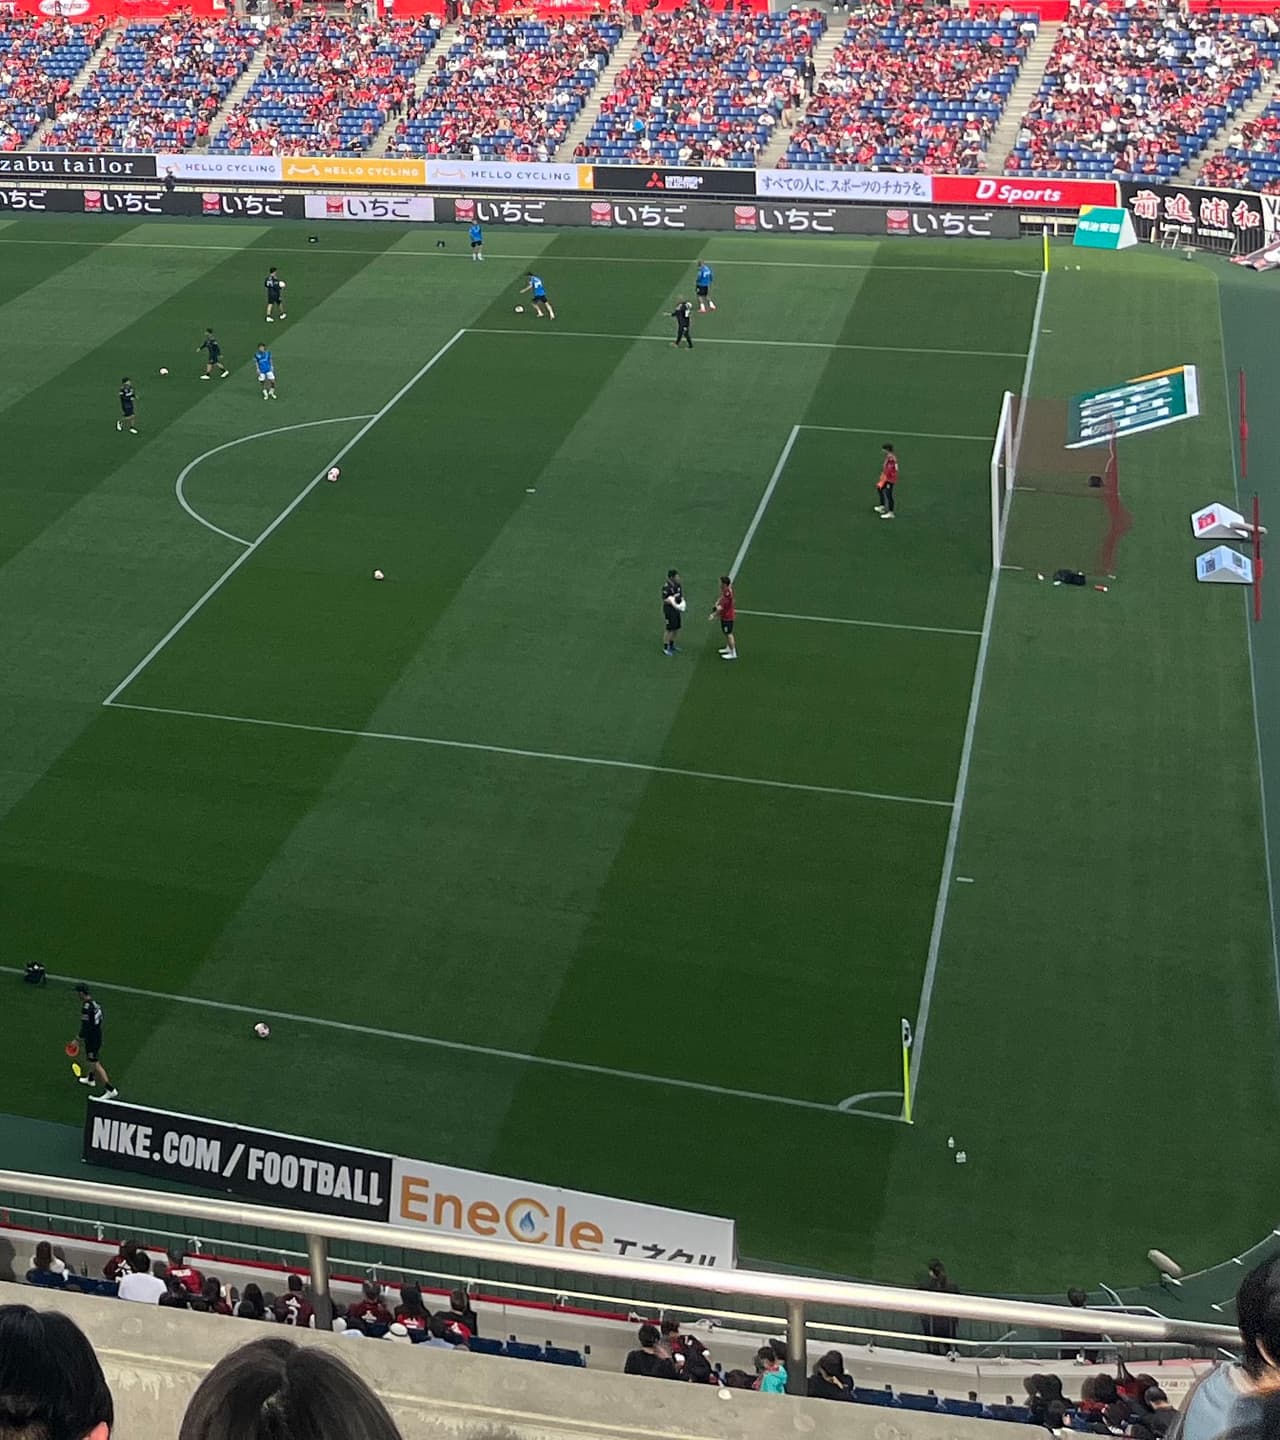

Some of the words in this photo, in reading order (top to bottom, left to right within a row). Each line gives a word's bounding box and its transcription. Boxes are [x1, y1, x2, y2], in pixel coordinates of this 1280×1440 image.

[64, 158, 134, 174] tailor
[185, 162, 223, 172] HELLO
[226, 163, 276, 173] CYCLING
[324, 166, 365, 177] HELLO
[368, 167, 421, 178] CYCLING
[471, 170, 512, 181] HELLO
[516, 170, 571, 182] CYCLING
[103, 192, 163, 213] いちご
[998, 184, 1062, 202] Sports
[222, 195, 285, 216] いちご
[347, 198, 412, 219] いちご
[477, 201, 545, 223] いちご
[614, 205, 687, 227] いちご
[1130, 190, 1261, 229] 前進浦和
[759, 208, 836, 231] いちご
[912, 212, 993, 236] いちご
[1079, 220, 1120, 234] 明治安田
[399, 1175, 604, 1251] EneCle
